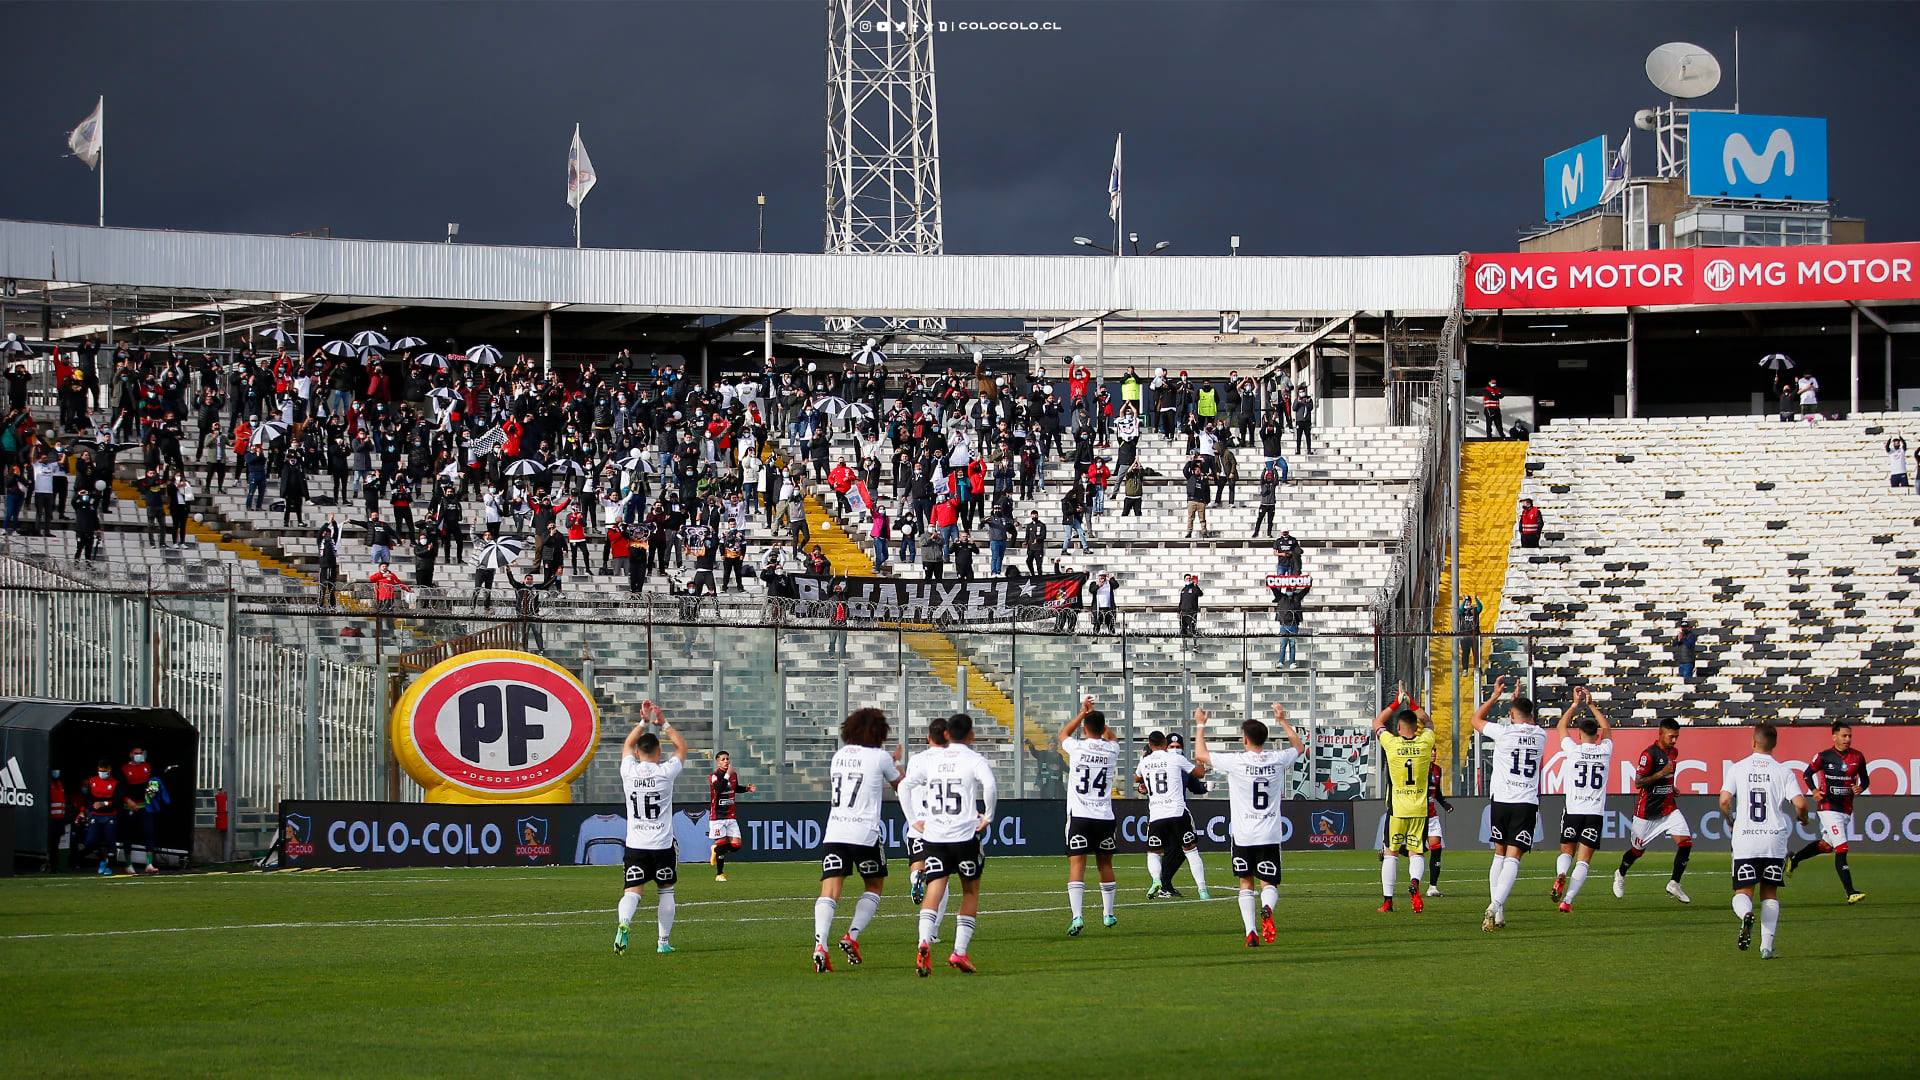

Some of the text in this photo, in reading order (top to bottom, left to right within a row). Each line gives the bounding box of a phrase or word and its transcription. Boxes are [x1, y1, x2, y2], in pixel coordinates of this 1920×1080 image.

[1510, 266, 1558, 289] MG
[1569, 263, 1683, 288] MOTOR
[1739, 262, 1786, 286] MG
[1798, 259, 1912, 284] MOTOR
[1221, 313, 1238, 332] 12
[1266, 576, 1312, 587] CONCON
[459, 685, 548, 766] PF
[1518, 737, 1535, 746] AMOR
[937, 763, 956, 773] CRUZ
[1080, 754, 1108, 764] PIZARRO
[1245, 765, 1276, 776] FUENTES
[1510, 748, 1538, 778] 15
[469, 771, 543, 783] DESDE 1903
[633, 779, 656, 788] OPAZO
[1075, 764, 1109, 797] 34
[1145, 770, 1168, 797] 18
[1404, 759, 1416, 786] 1
[1574, 760, 1605, 790] 36
[1748, 773, 1771, 783] COSTA
[831, 772, 864, 808] 37
[929, 778, 962, 816] 35
[1253, 777, 1269, 810] 6
[630, 791, 661, 820] 16
[1749, 787, 1767, 823] 8
[328, 820, 502, 854] COLO-COLO
[1309, 836, 1348, 844] COLO-COLO
[1831, 825, 1840, 836] 6
[516, 846, 550, 855] COLO-COLO
